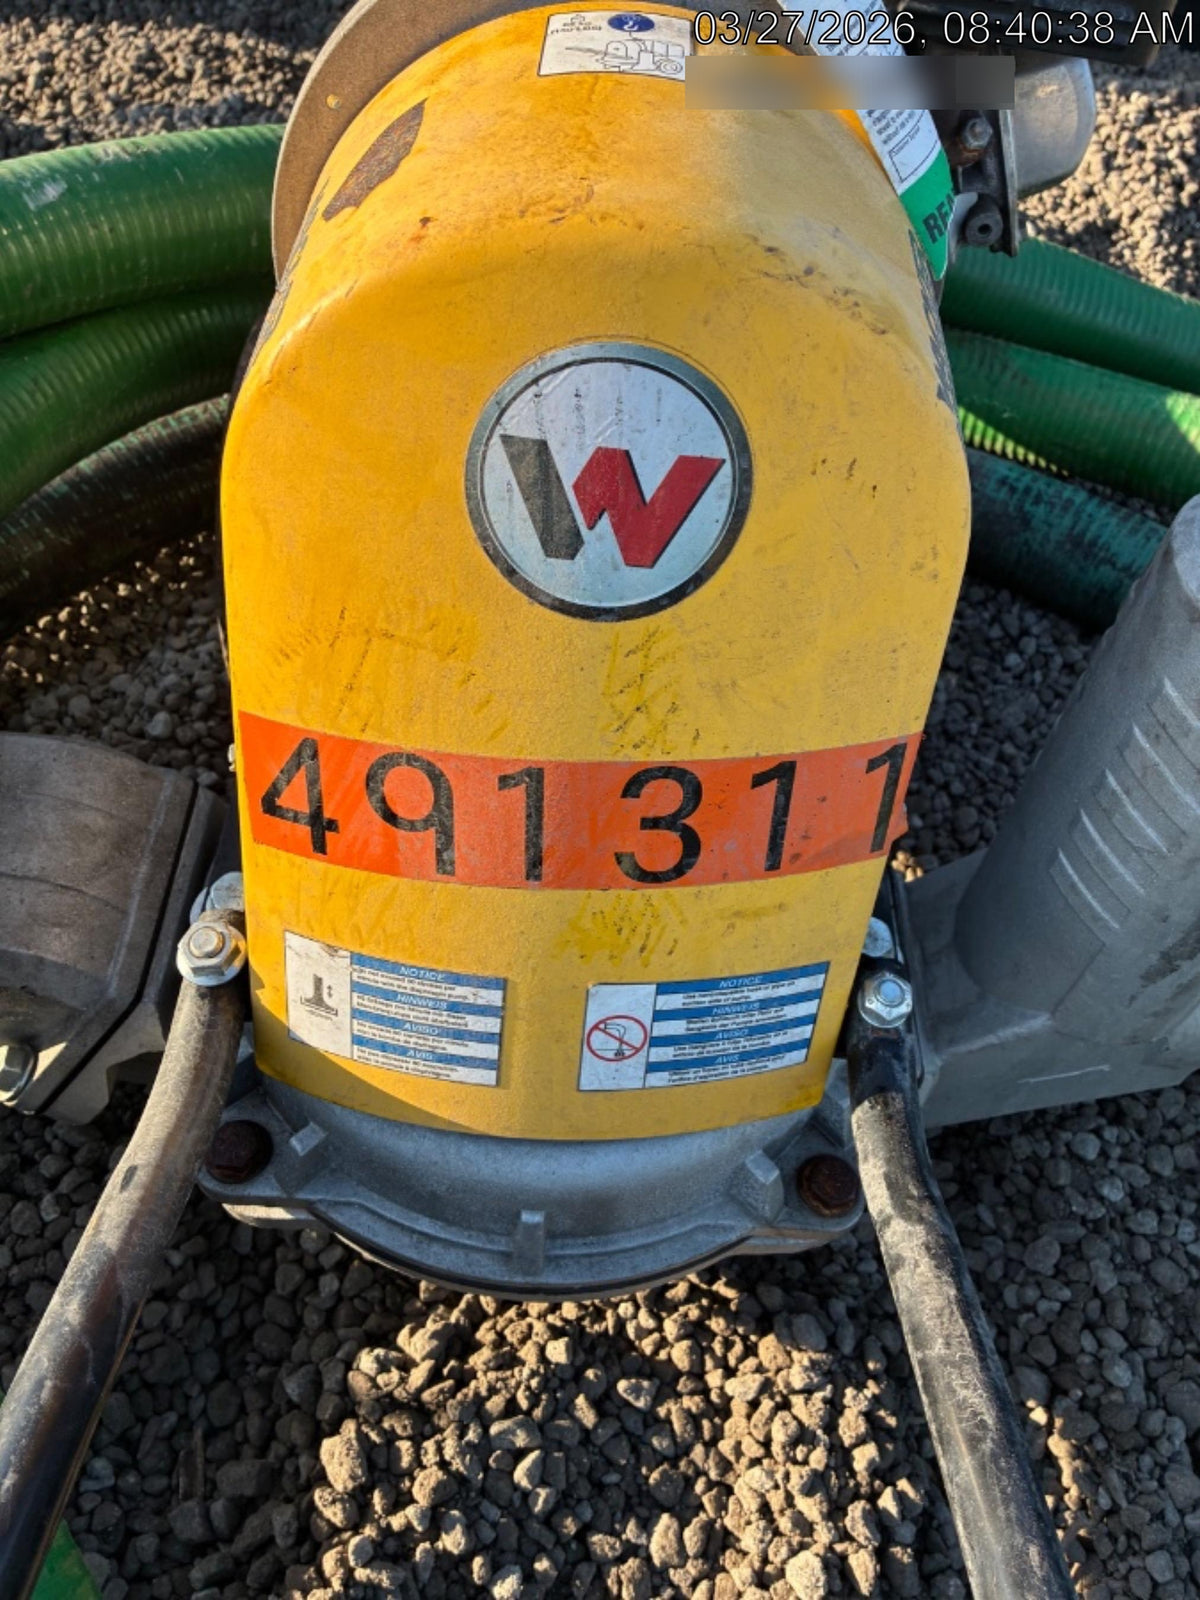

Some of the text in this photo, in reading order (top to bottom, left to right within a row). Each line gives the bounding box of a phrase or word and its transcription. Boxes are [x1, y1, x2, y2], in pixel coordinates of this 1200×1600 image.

[260, 736, 908, 885] 491311
[400, 966, 446, 981] NOTICE
[718, 976, 763, 988] NOTICE
[402, 1022, 438, 1035] AVISO
[405, 1049, 434, 1061] AVIS
